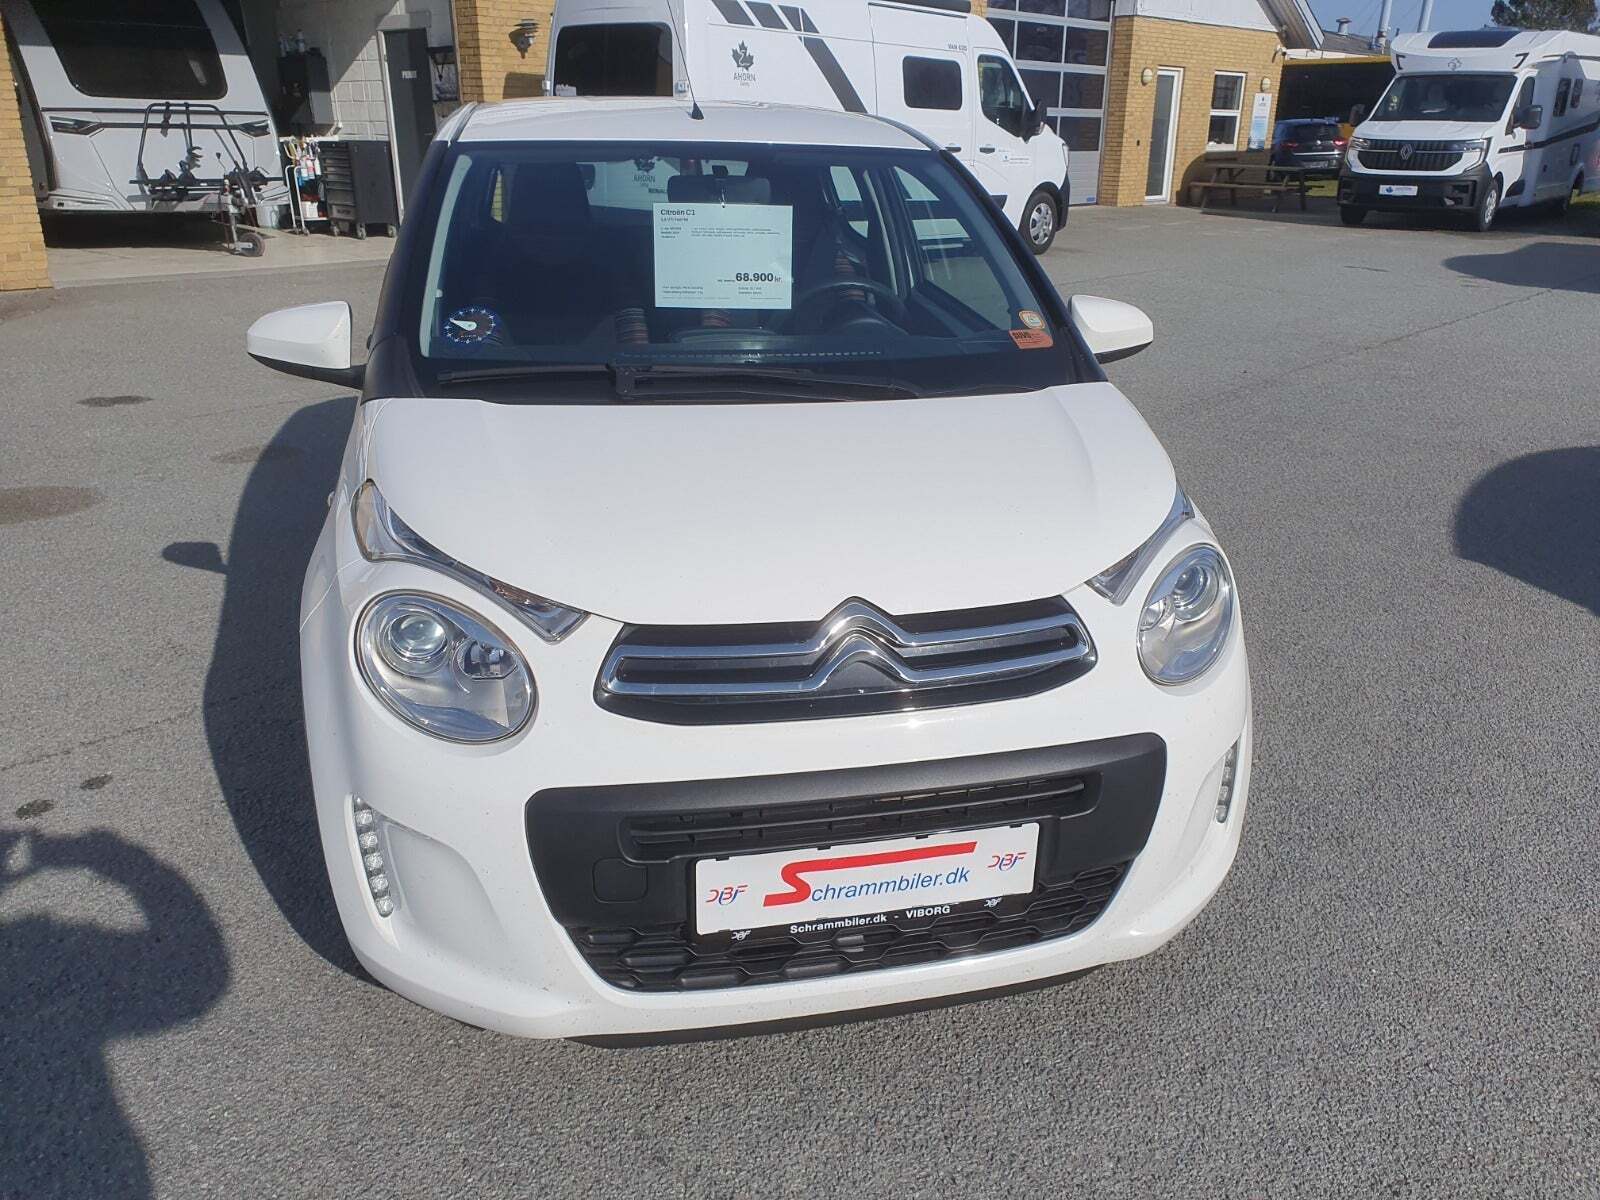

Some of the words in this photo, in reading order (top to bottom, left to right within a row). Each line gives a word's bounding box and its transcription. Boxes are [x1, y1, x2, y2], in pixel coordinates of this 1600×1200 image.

[733, 73, 756, 82] AHORN
[686, 209, 696, 217] C1
[735, 272, 774, 283] 68.900
[763, 841, 977, 908] Schrammbiler.dk
[789, 913, 888, 935] Schrammbiler.dk
[905, 904, 951, 919] VIBORG
